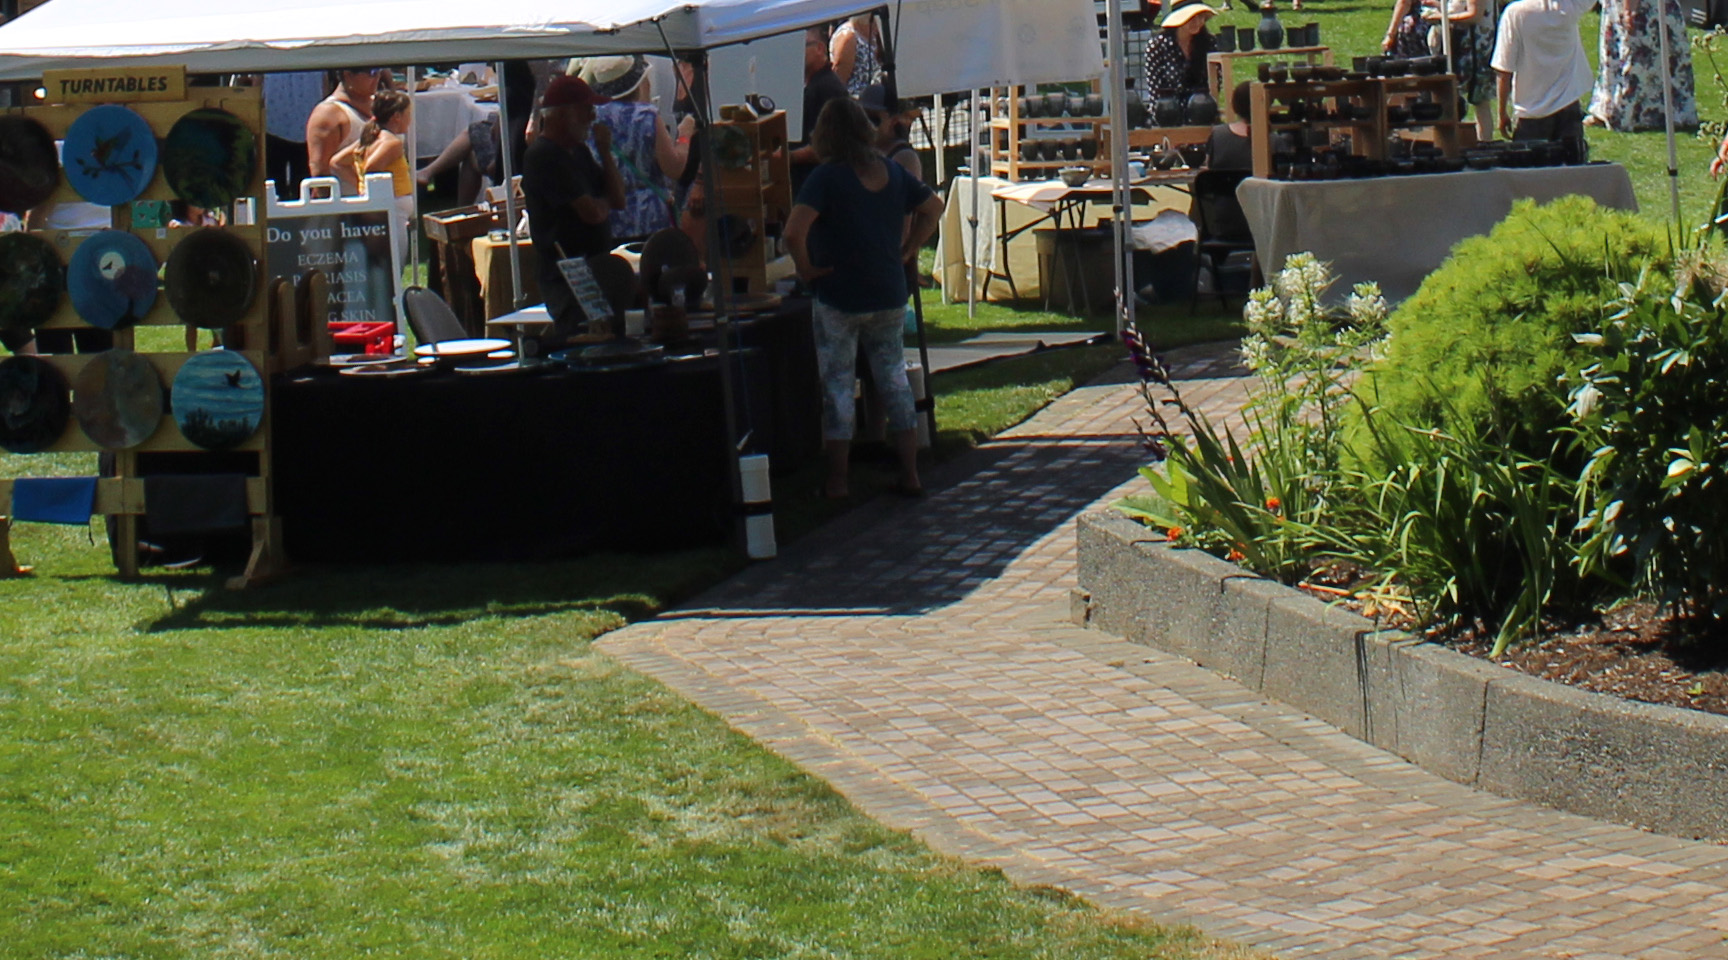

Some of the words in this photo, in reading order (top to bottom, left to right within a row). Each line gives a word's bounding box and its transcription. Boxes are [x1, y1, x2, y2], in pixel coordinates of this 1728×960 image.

[59, 76, 168, 95] TURNTABLES
[266, 227, 291, 243] Do
[300, 228, 332, 246] you
[340, 221, 387, 238] have:
[297, 251, 359, 266] ECZEMA
[292, 271, 367, 287] PIASIS
